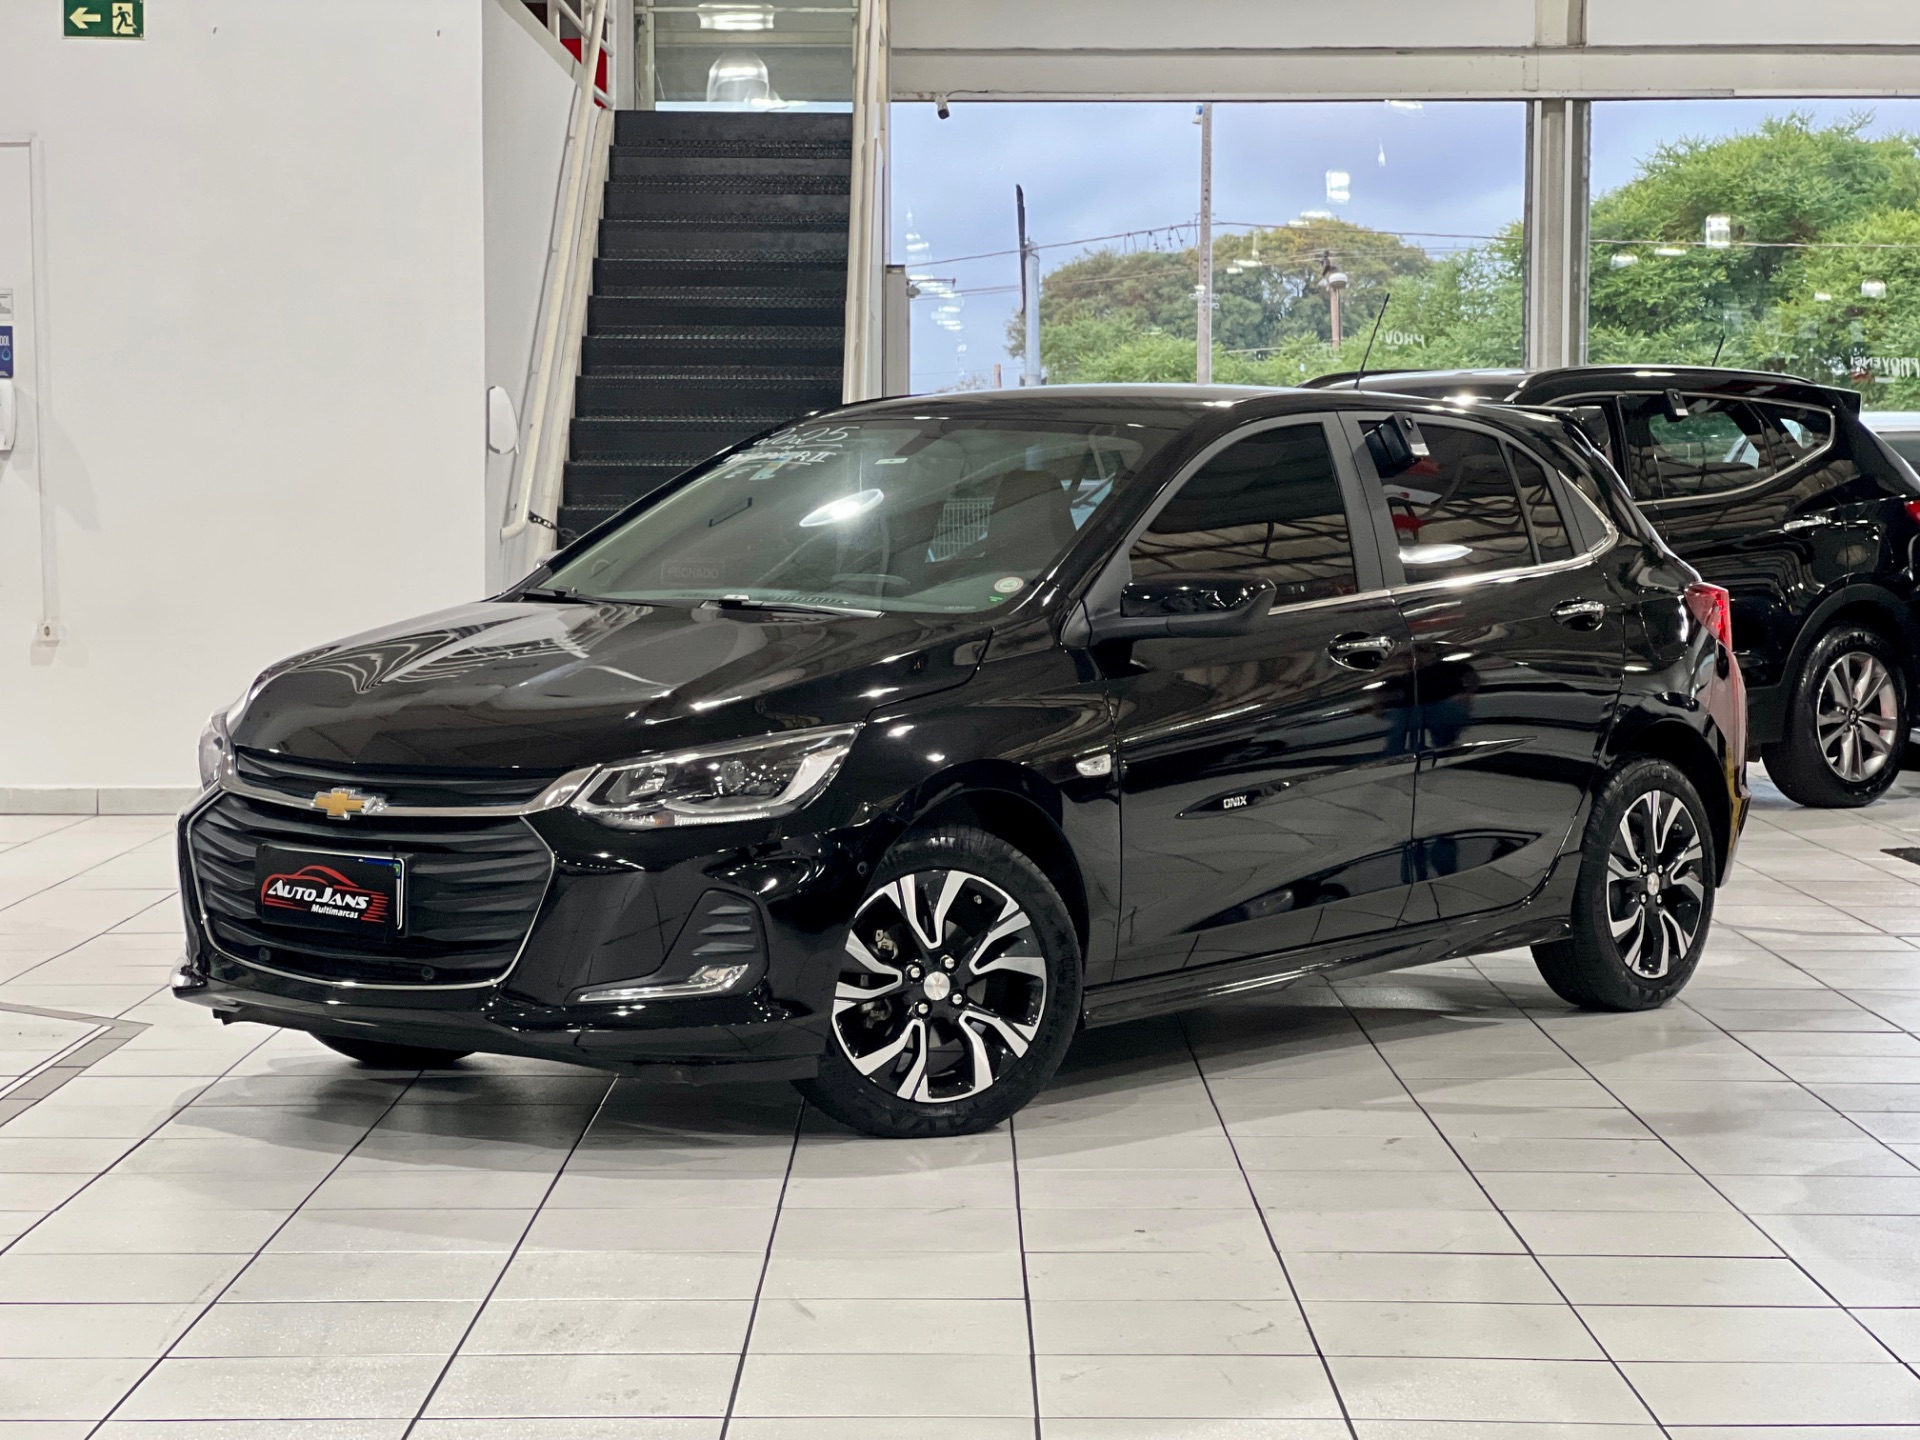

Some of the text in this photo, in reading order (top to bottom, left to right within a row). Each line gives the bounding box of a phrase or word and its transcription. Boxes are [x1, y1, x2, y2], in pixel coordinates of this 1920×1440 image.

[753, 426, 860, 446] 2025
[1223, 795, 1248, 809] ONIX
[267, 879, 370, 910] AUTO JANS
[310, 903, 360, 919] Multimarcas
